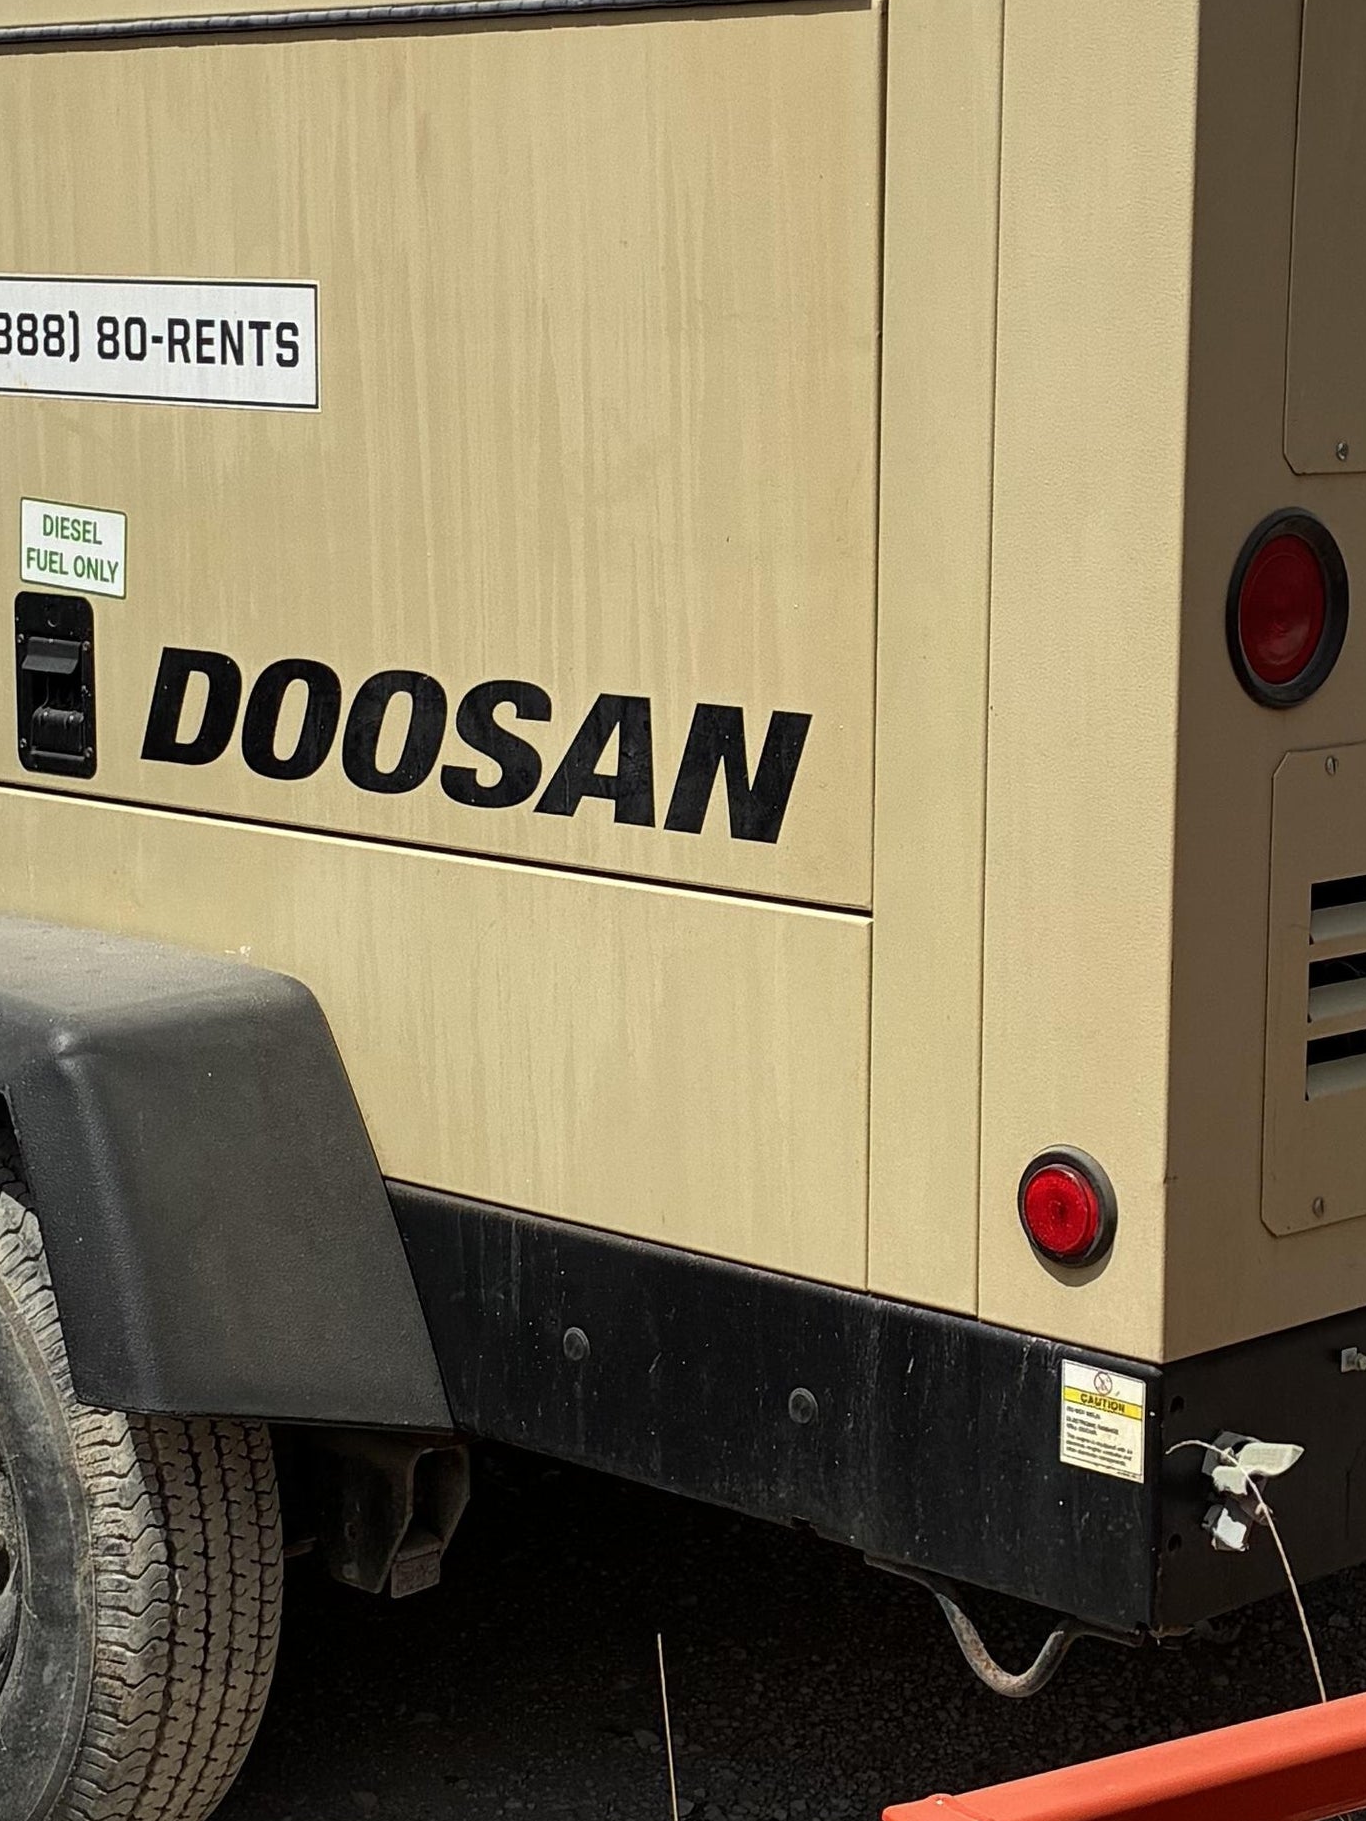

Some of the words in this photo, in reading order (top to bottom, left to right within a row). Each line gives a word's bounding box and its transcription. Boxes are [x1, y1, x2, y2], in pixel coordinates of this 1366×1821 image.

[95, 315, 300, 368] 80-RENTS
[42, 513, 103, 546] DIESEL
[26, 546, 70, 576] FUEL
[73, 554, 119, 584] ONLY
[139, 645, 814, 845] DOOSAN
[1080, 1393, 1126, 1414] CAUTION
